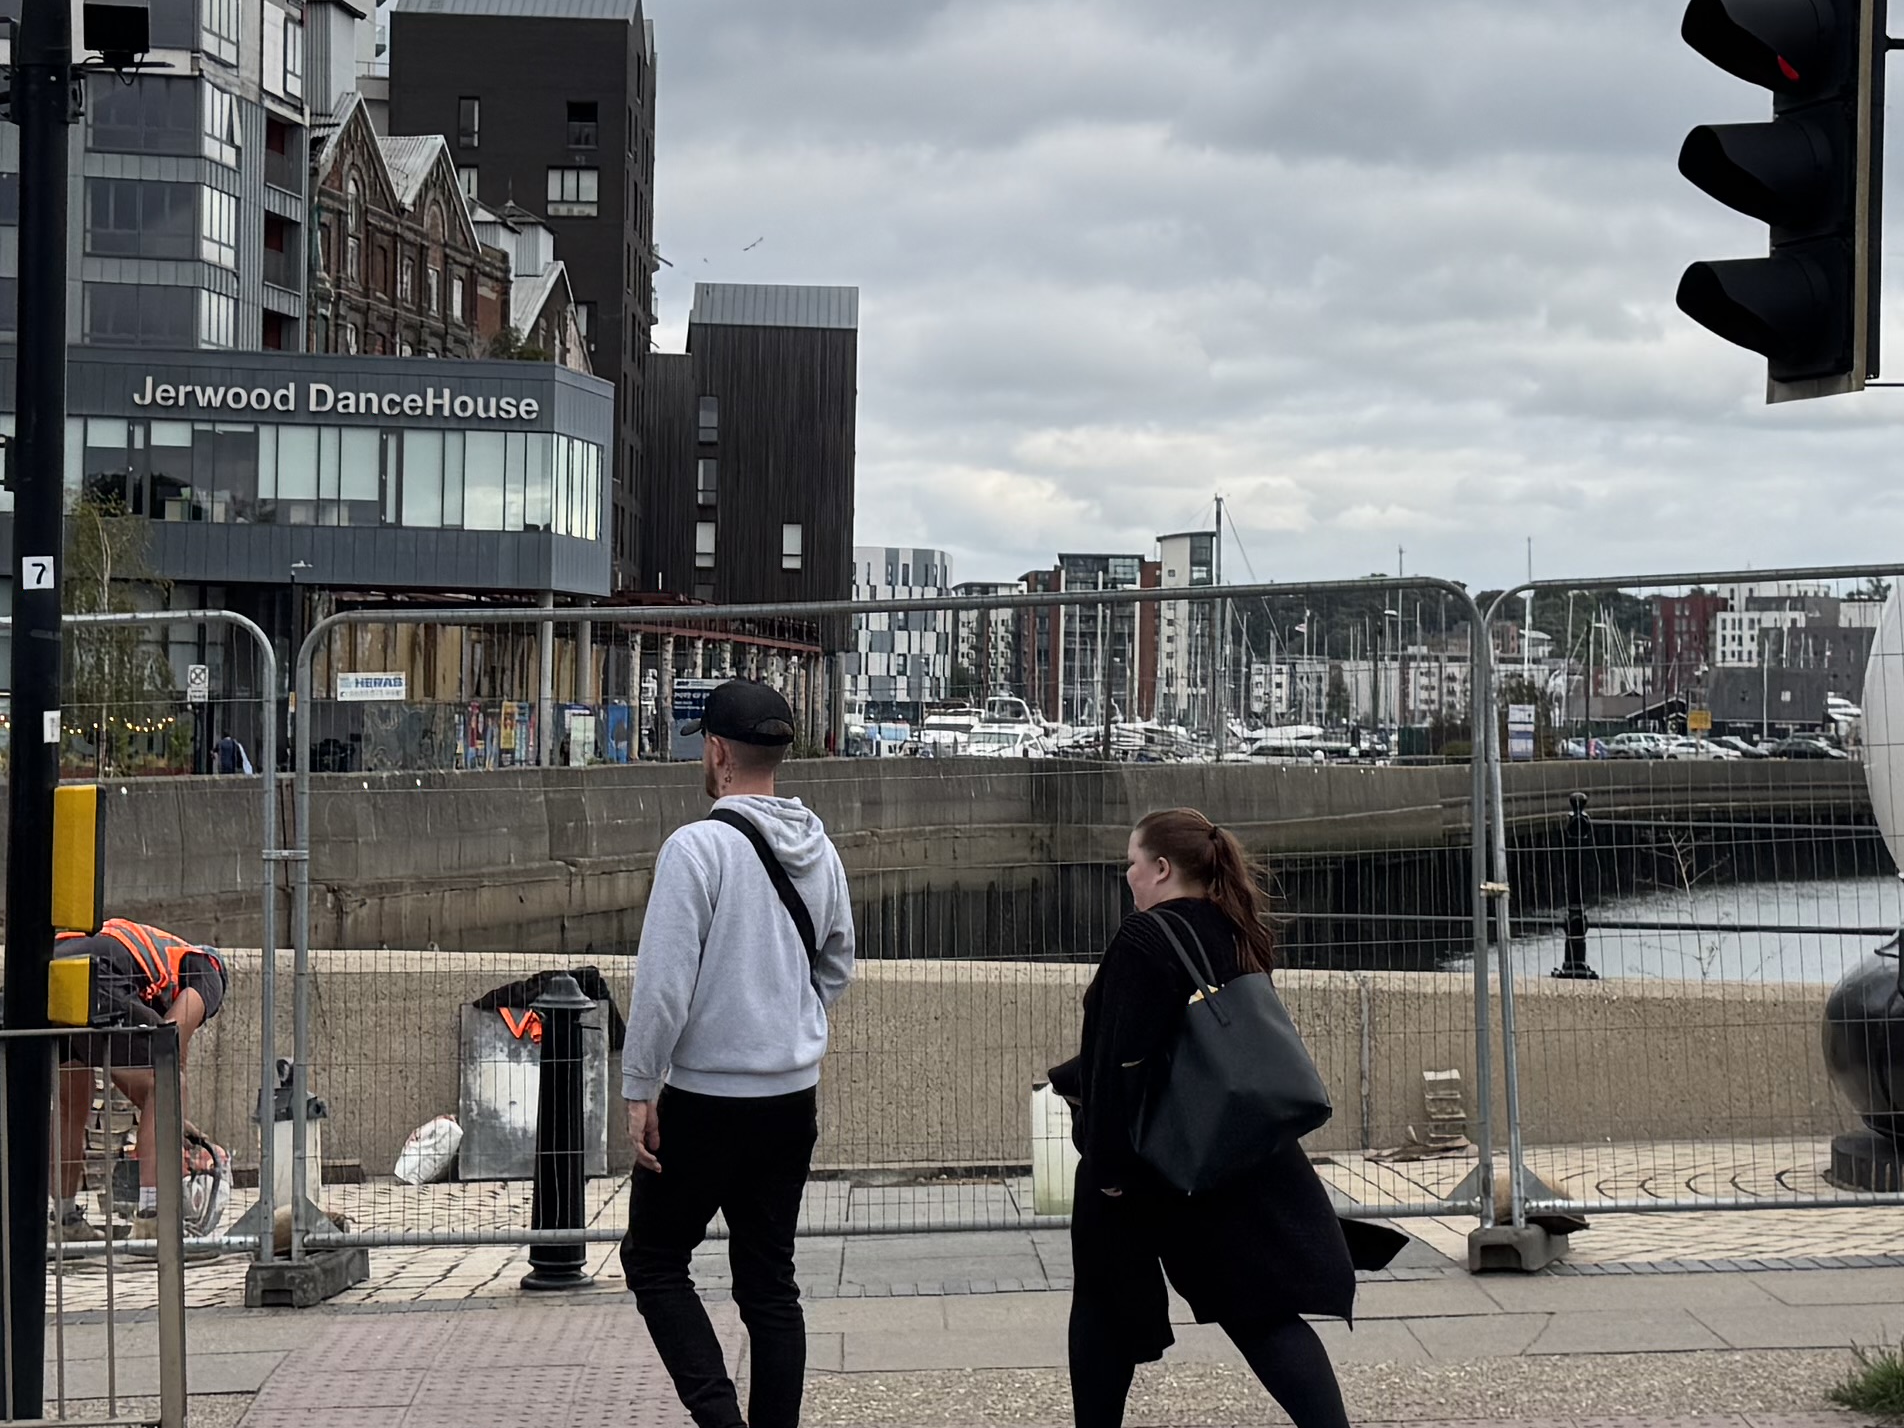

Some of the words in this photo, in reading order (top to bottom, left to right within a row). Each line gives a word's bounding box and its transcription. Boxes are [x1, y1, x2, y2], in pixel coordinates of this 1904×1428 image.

[132, 375, 296, 413] Jerwood
[308, 382, 539, 420] DanceHouse
[32, 563, 46, 585] 7
